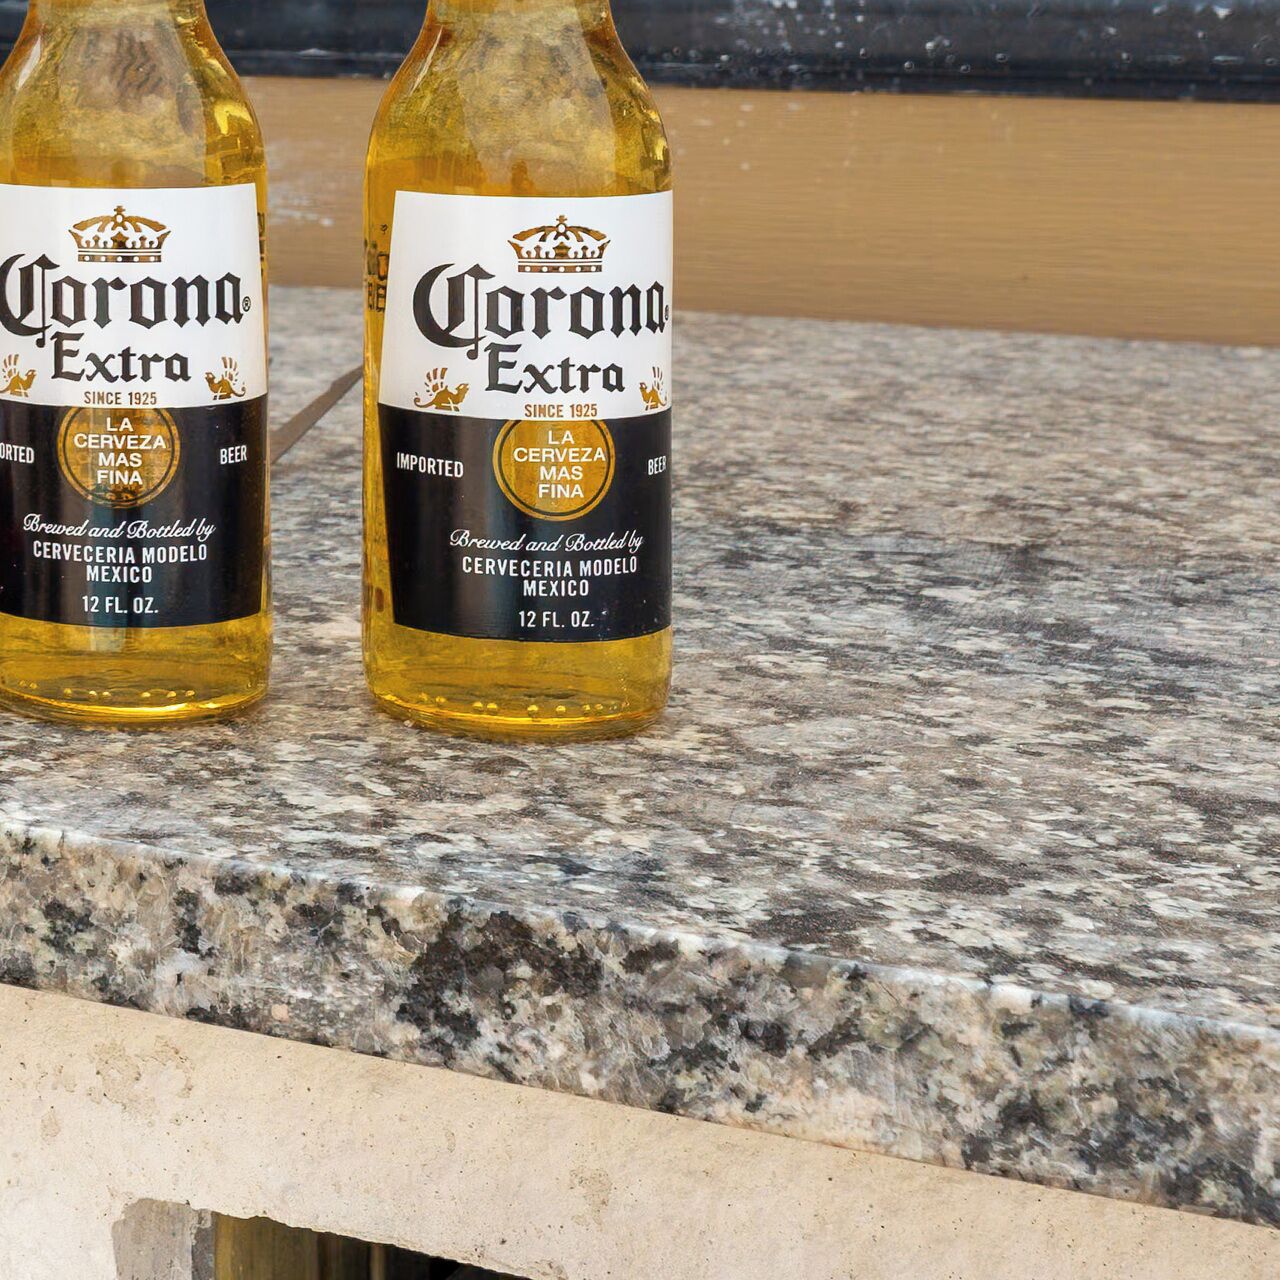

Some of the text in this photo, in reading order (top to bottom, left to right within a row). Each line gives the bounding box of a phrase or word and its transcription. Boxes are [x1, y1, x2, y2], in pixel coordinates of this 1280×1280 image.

[49, 331, 192, 383] Extra
[484, 342, 626, 394] Extra
[83, 391, 158, 406] SINCE 1925
[524, 403, 598, 419] SINCE 1925
[106, 417, 134, 433] LA
[73, 433, 167, 450] CERVEZA
[548, 430, 575, 446] LA
[97, 452, 143, 468] MAS
[219, 444, 248, 465] BEER
[513, 446, 606, 463] CERVEZA
[396, 452, 464, 478] IMPORTED
[539, 465, 583, 481] MAS
[647, 455, 667, 476] BEER
[96, 470, 144, 486] FINA
[538, 483, 584, 499] FINA
[23, 513, 216, 542] Brewed and Bottled by
[449, 529, 644, 554] Brewed and Bottled by
[32, 540, 208, 564] CERVECERIA MODELO
[86, 565, 153, 583] MEXICO
[462, 556, 638, 577] CERVECERIA MODELO
[523, 579, 589, 597] MEXICO
[82, 596, 159, 613] 12 FL. OZ.
[519, 610, 595, 628] 12 FL. OZ.
